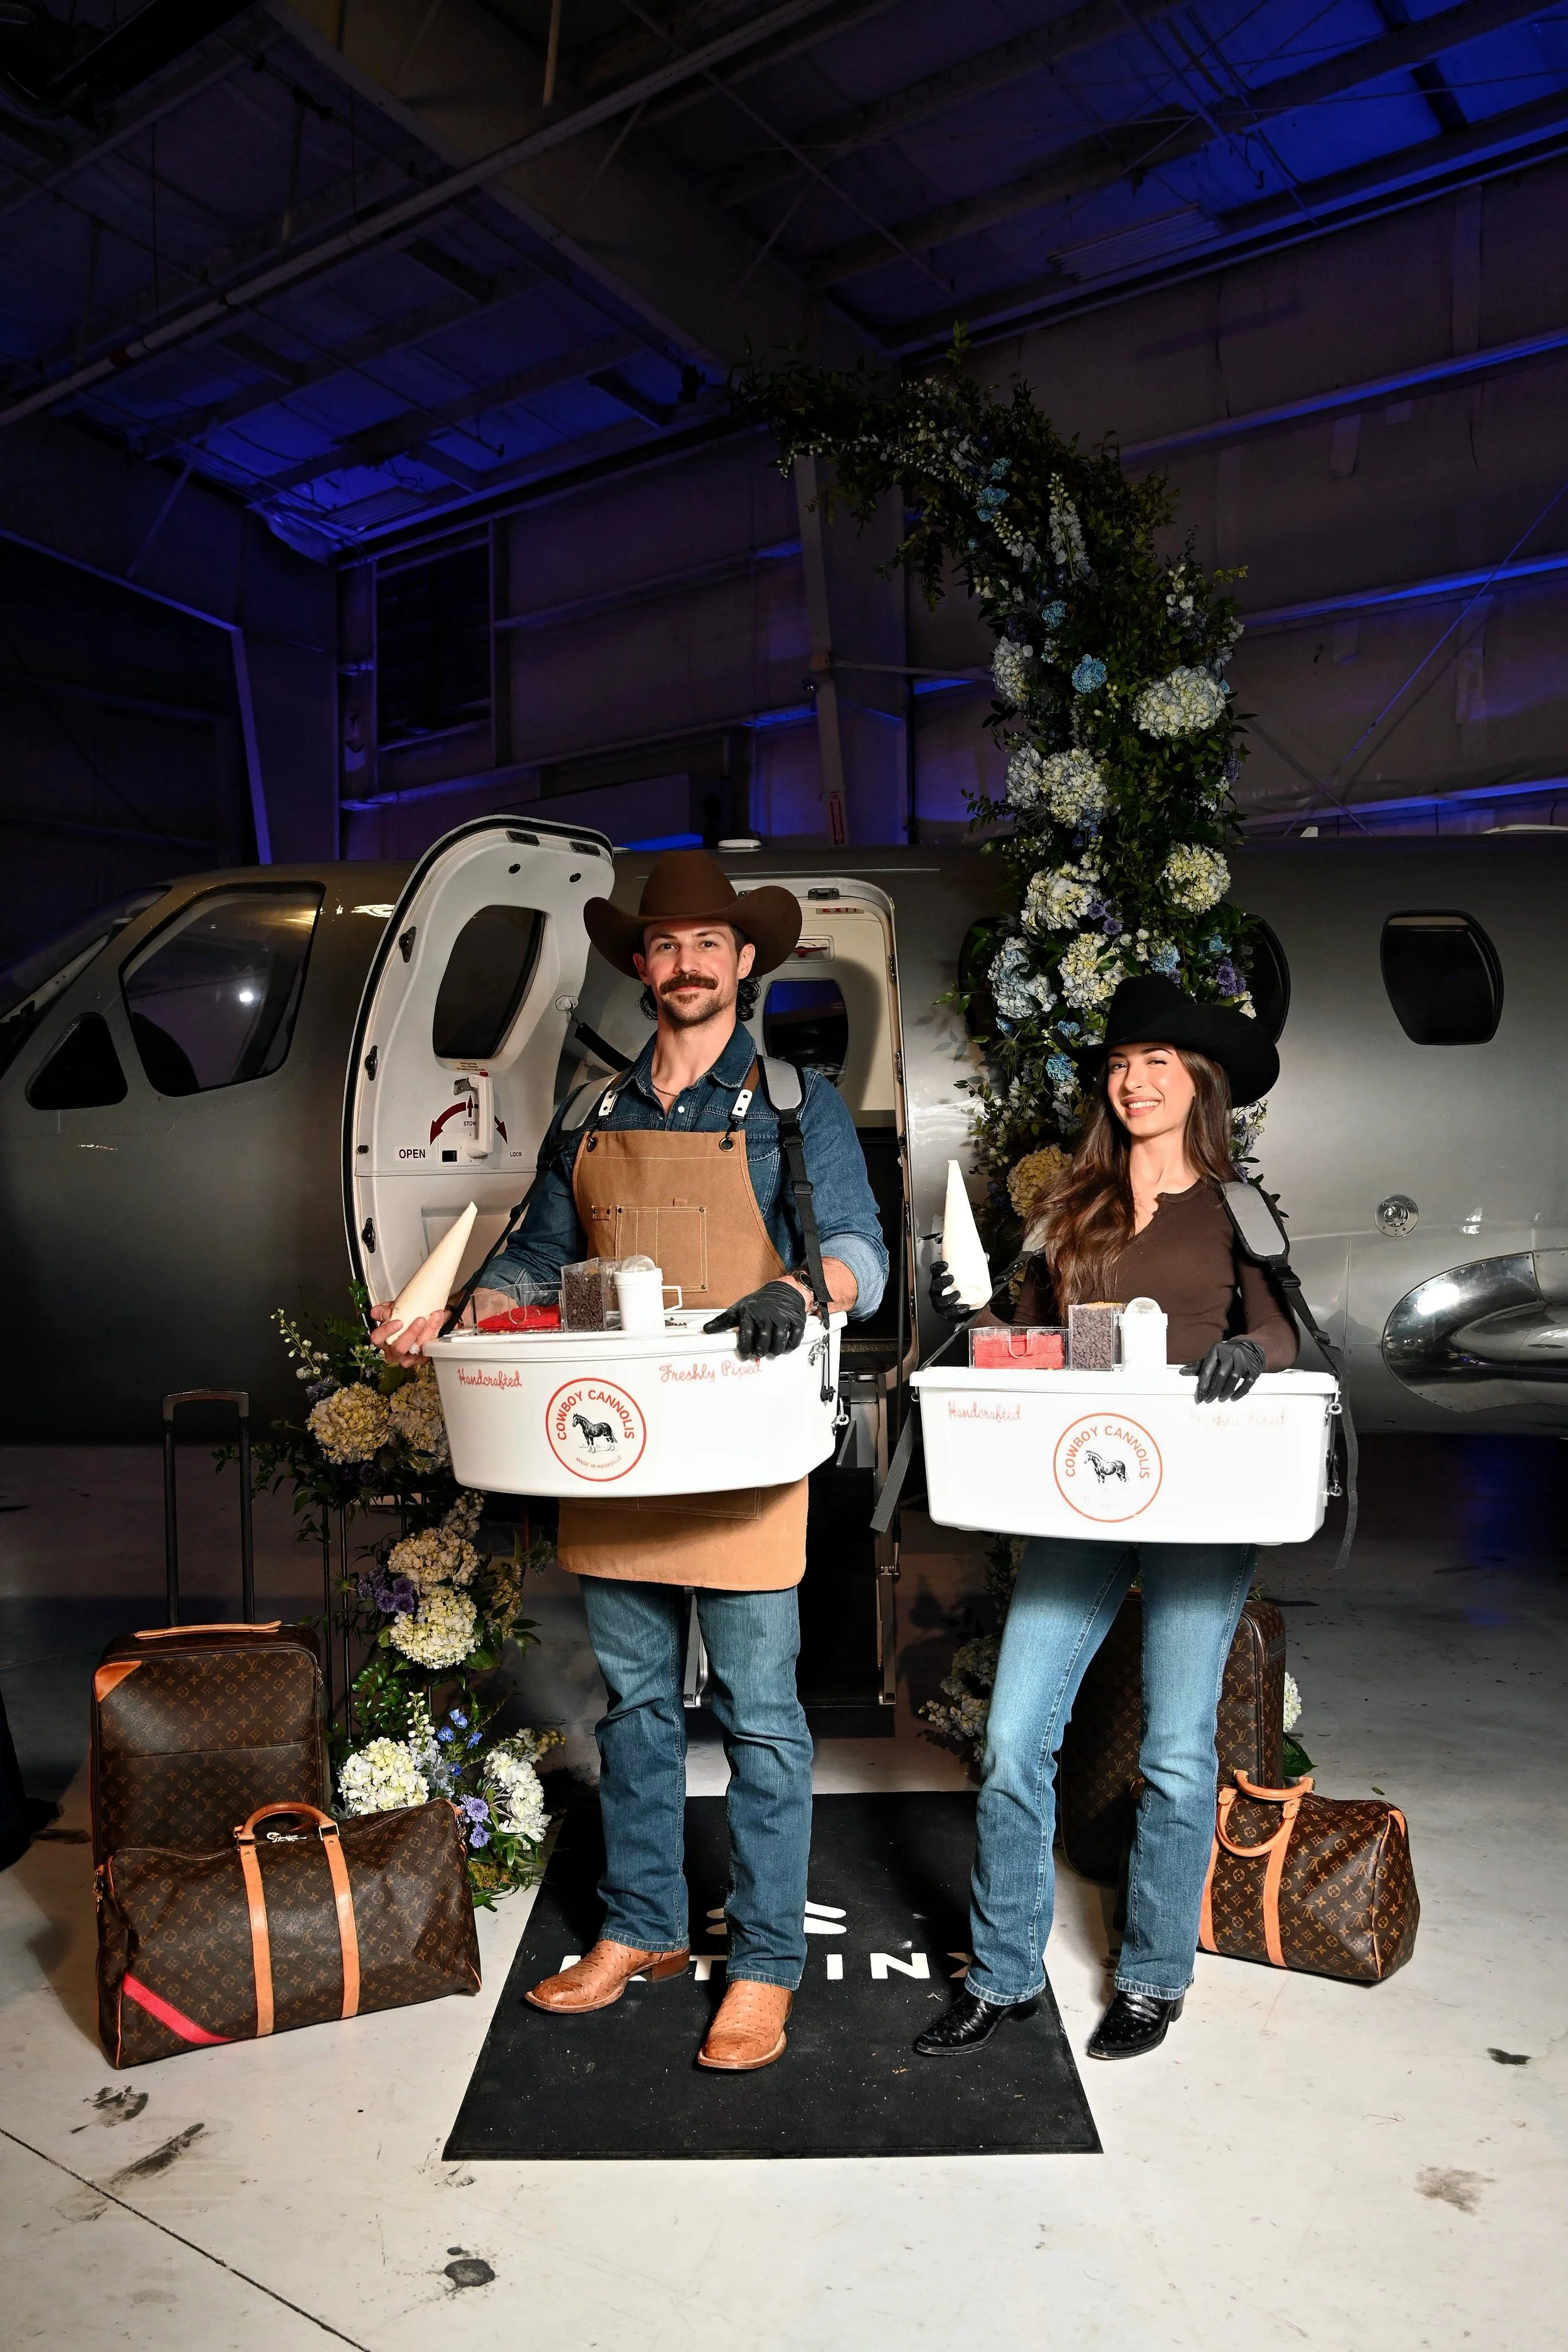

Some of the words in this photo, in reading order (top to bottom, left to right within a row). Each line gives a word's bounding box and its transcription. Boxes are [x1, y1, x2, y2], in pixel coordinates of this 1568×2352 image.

[399, 1149, 426, 1158] OPEN
[457, 1368, 522, 1390] Handcrafted
[659, 1364, 715, 1382] Freshly
[556, 1391, 583, 1441] COWBOY
[588, 1389, 635, 1439] CANNOLIS
[948, 1400, 1022, 1423] Handcrafted
[1065, 1426, 1098, 1477] COWBOY
[1104, 1425, 1150, 1479] CANNOLIS
